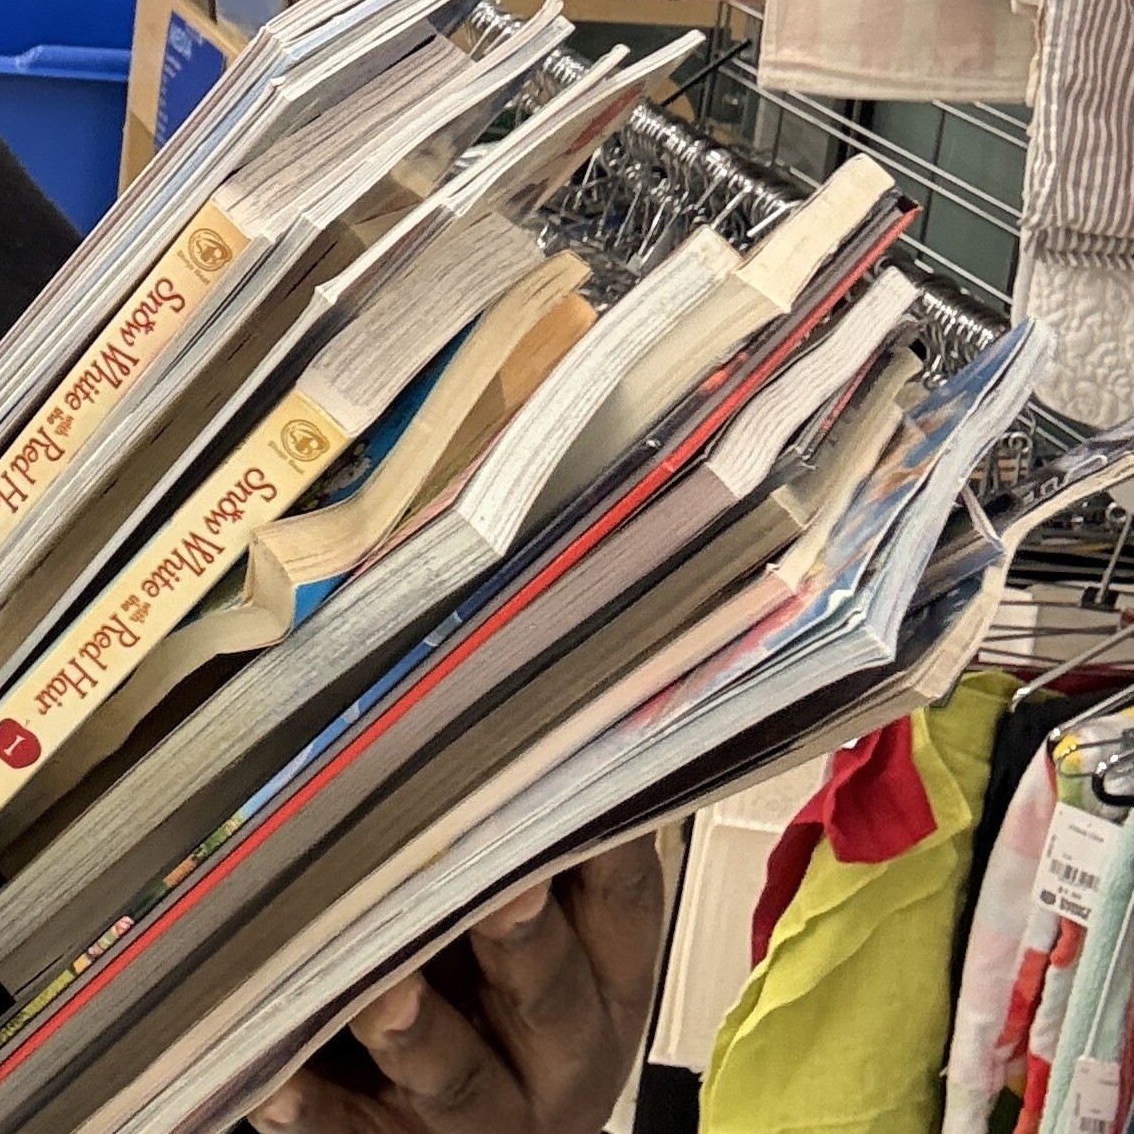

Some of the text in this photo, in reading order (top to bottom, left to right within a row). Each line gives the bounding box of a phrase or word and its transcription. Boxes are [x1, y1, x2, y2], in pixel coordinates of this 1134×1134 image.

[119, 276, 186, 347] Snow
[64, 342, 140, 411] White
[9, 425, 66, 486] Red
[202, 466, 278, 535] Snow
[140, 531, 226, 598] White
[78, 611, 141, 671] Red
[34, 656, 99, 716] Hair
[3, 734, 27, 757] 1
